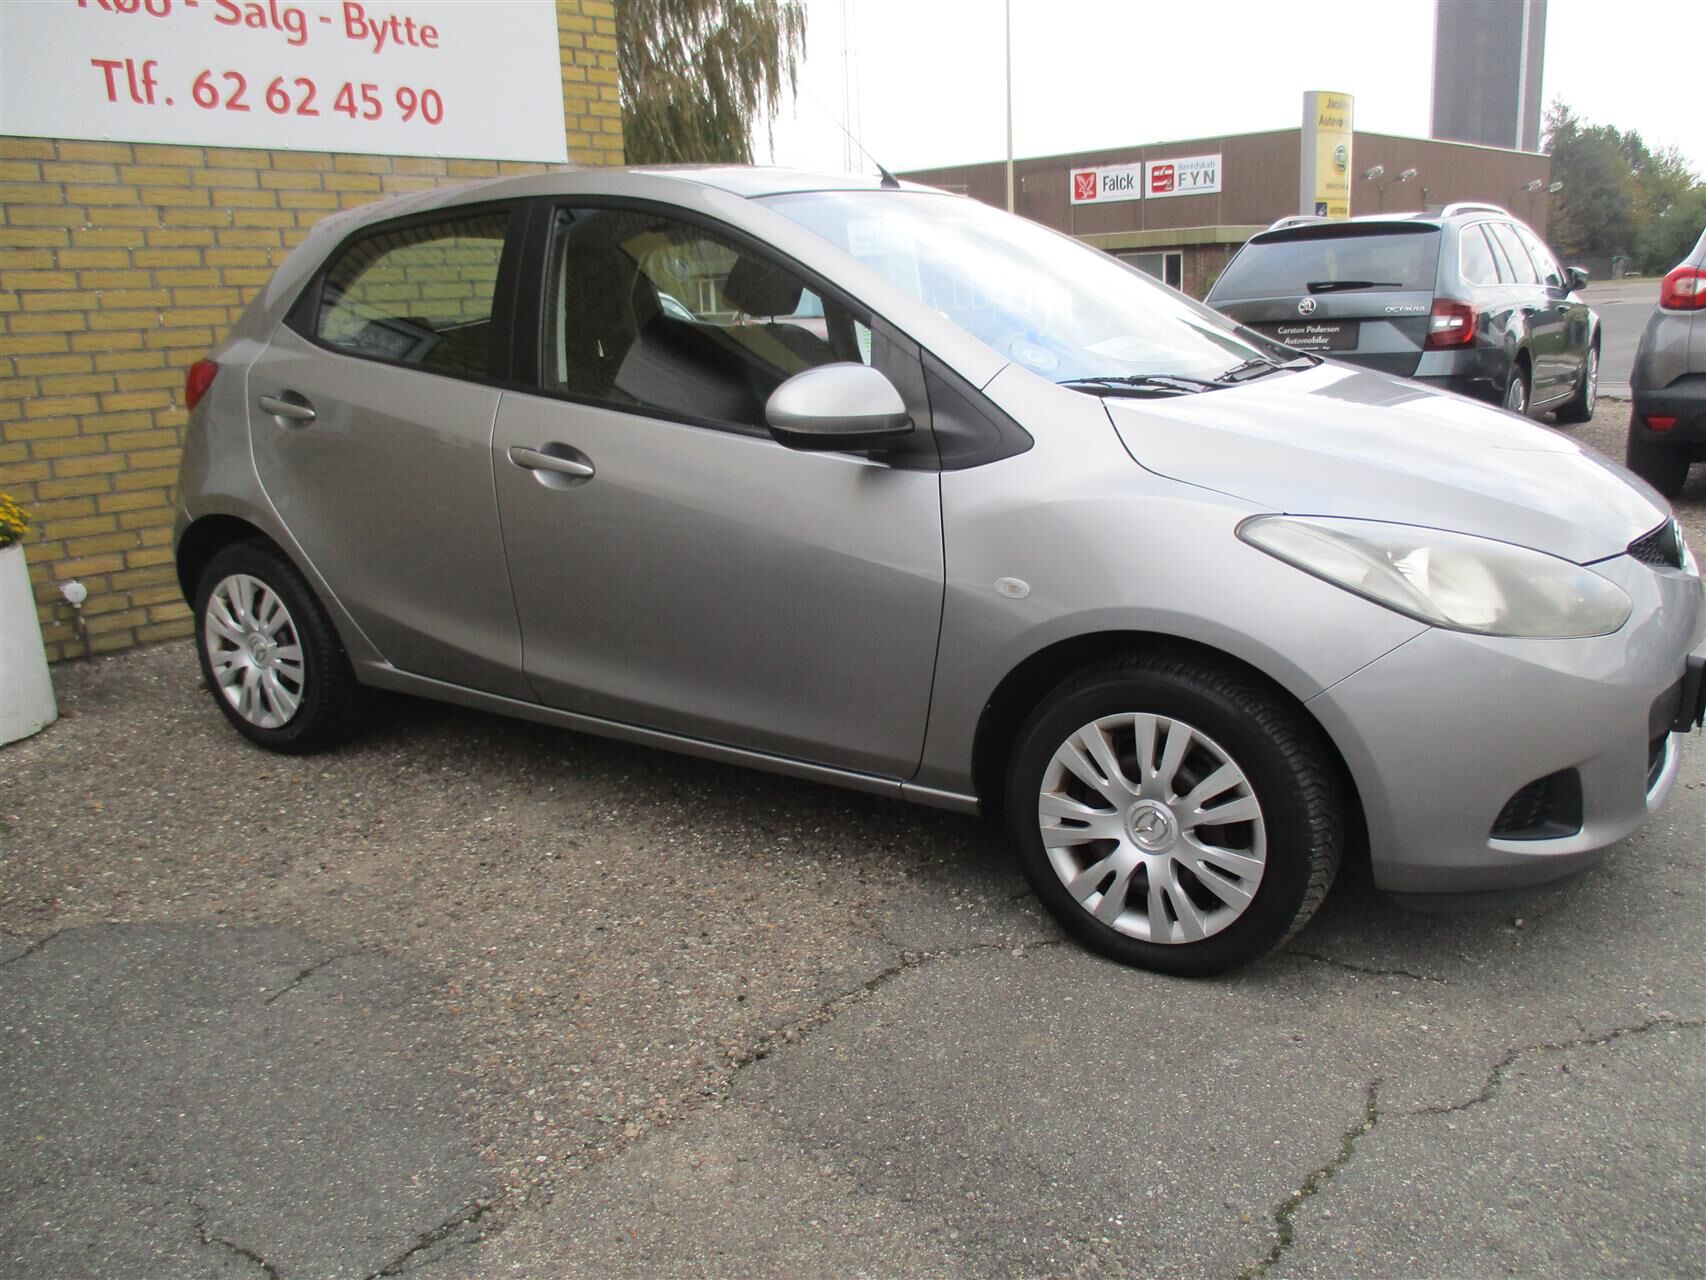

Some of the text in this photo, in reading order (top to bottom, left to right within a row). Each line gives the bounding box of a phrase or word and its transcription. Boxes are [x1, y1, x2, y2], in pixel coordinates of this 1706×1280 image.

[214, 0, 309, 47] Salg
[343, 1, 440, 54] Bytte
[91, 58, 444, 126] Tlf. 62 62 45 90
[1102, 171, 1135, 192] Falck
[1178, 169, 1215, 187] FYN
[1277, 324, 1340, 335] Carsten Pedersen
[1284, 336, 1329, 345] Automobiler
